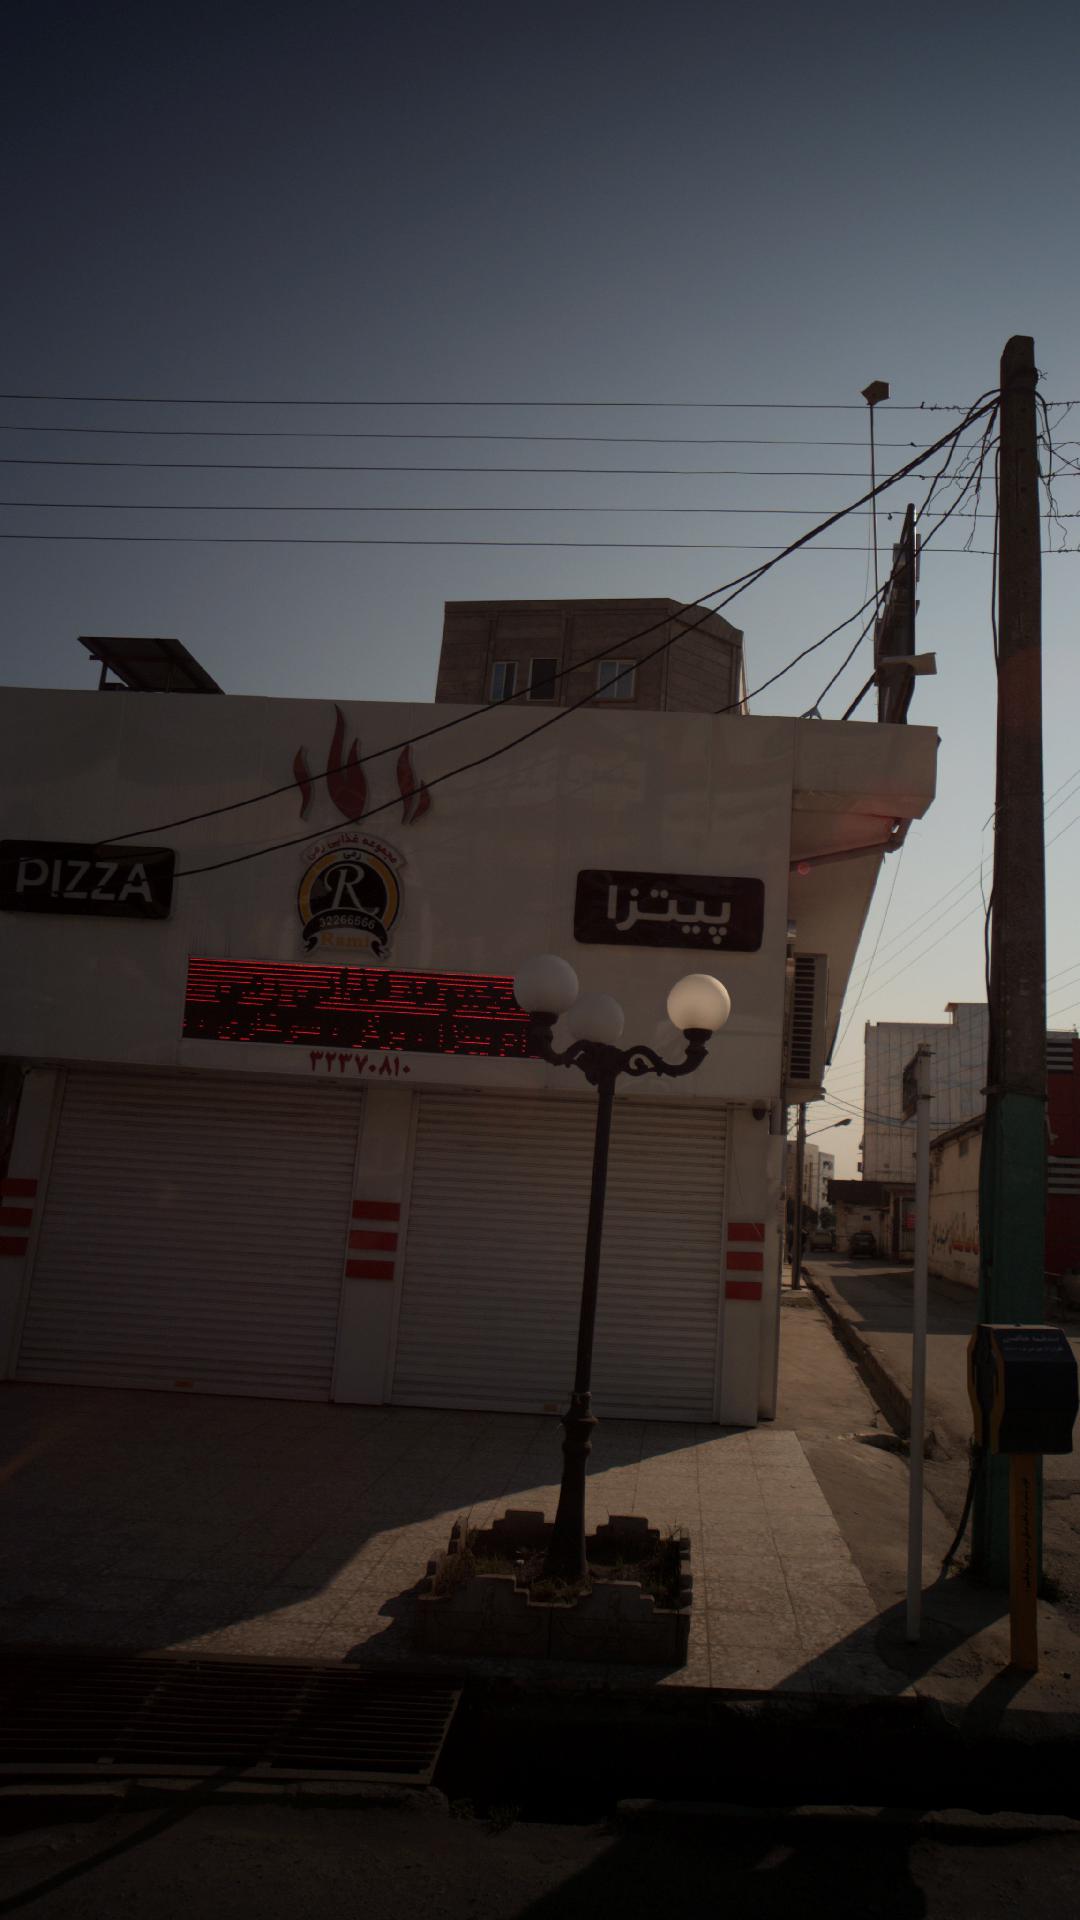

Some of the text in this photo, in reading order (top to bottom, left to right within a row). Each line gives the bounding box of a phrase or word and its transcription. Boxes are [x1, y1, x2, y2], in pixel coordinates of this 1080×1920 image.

[15, 857, 152, 903] PIZZA
[324, 862, 381, 915] R
[606, 884, 732, 945] پیتزا
[309, 1049, 411, 1077] ۳۲۳۷۰۸۱۰
